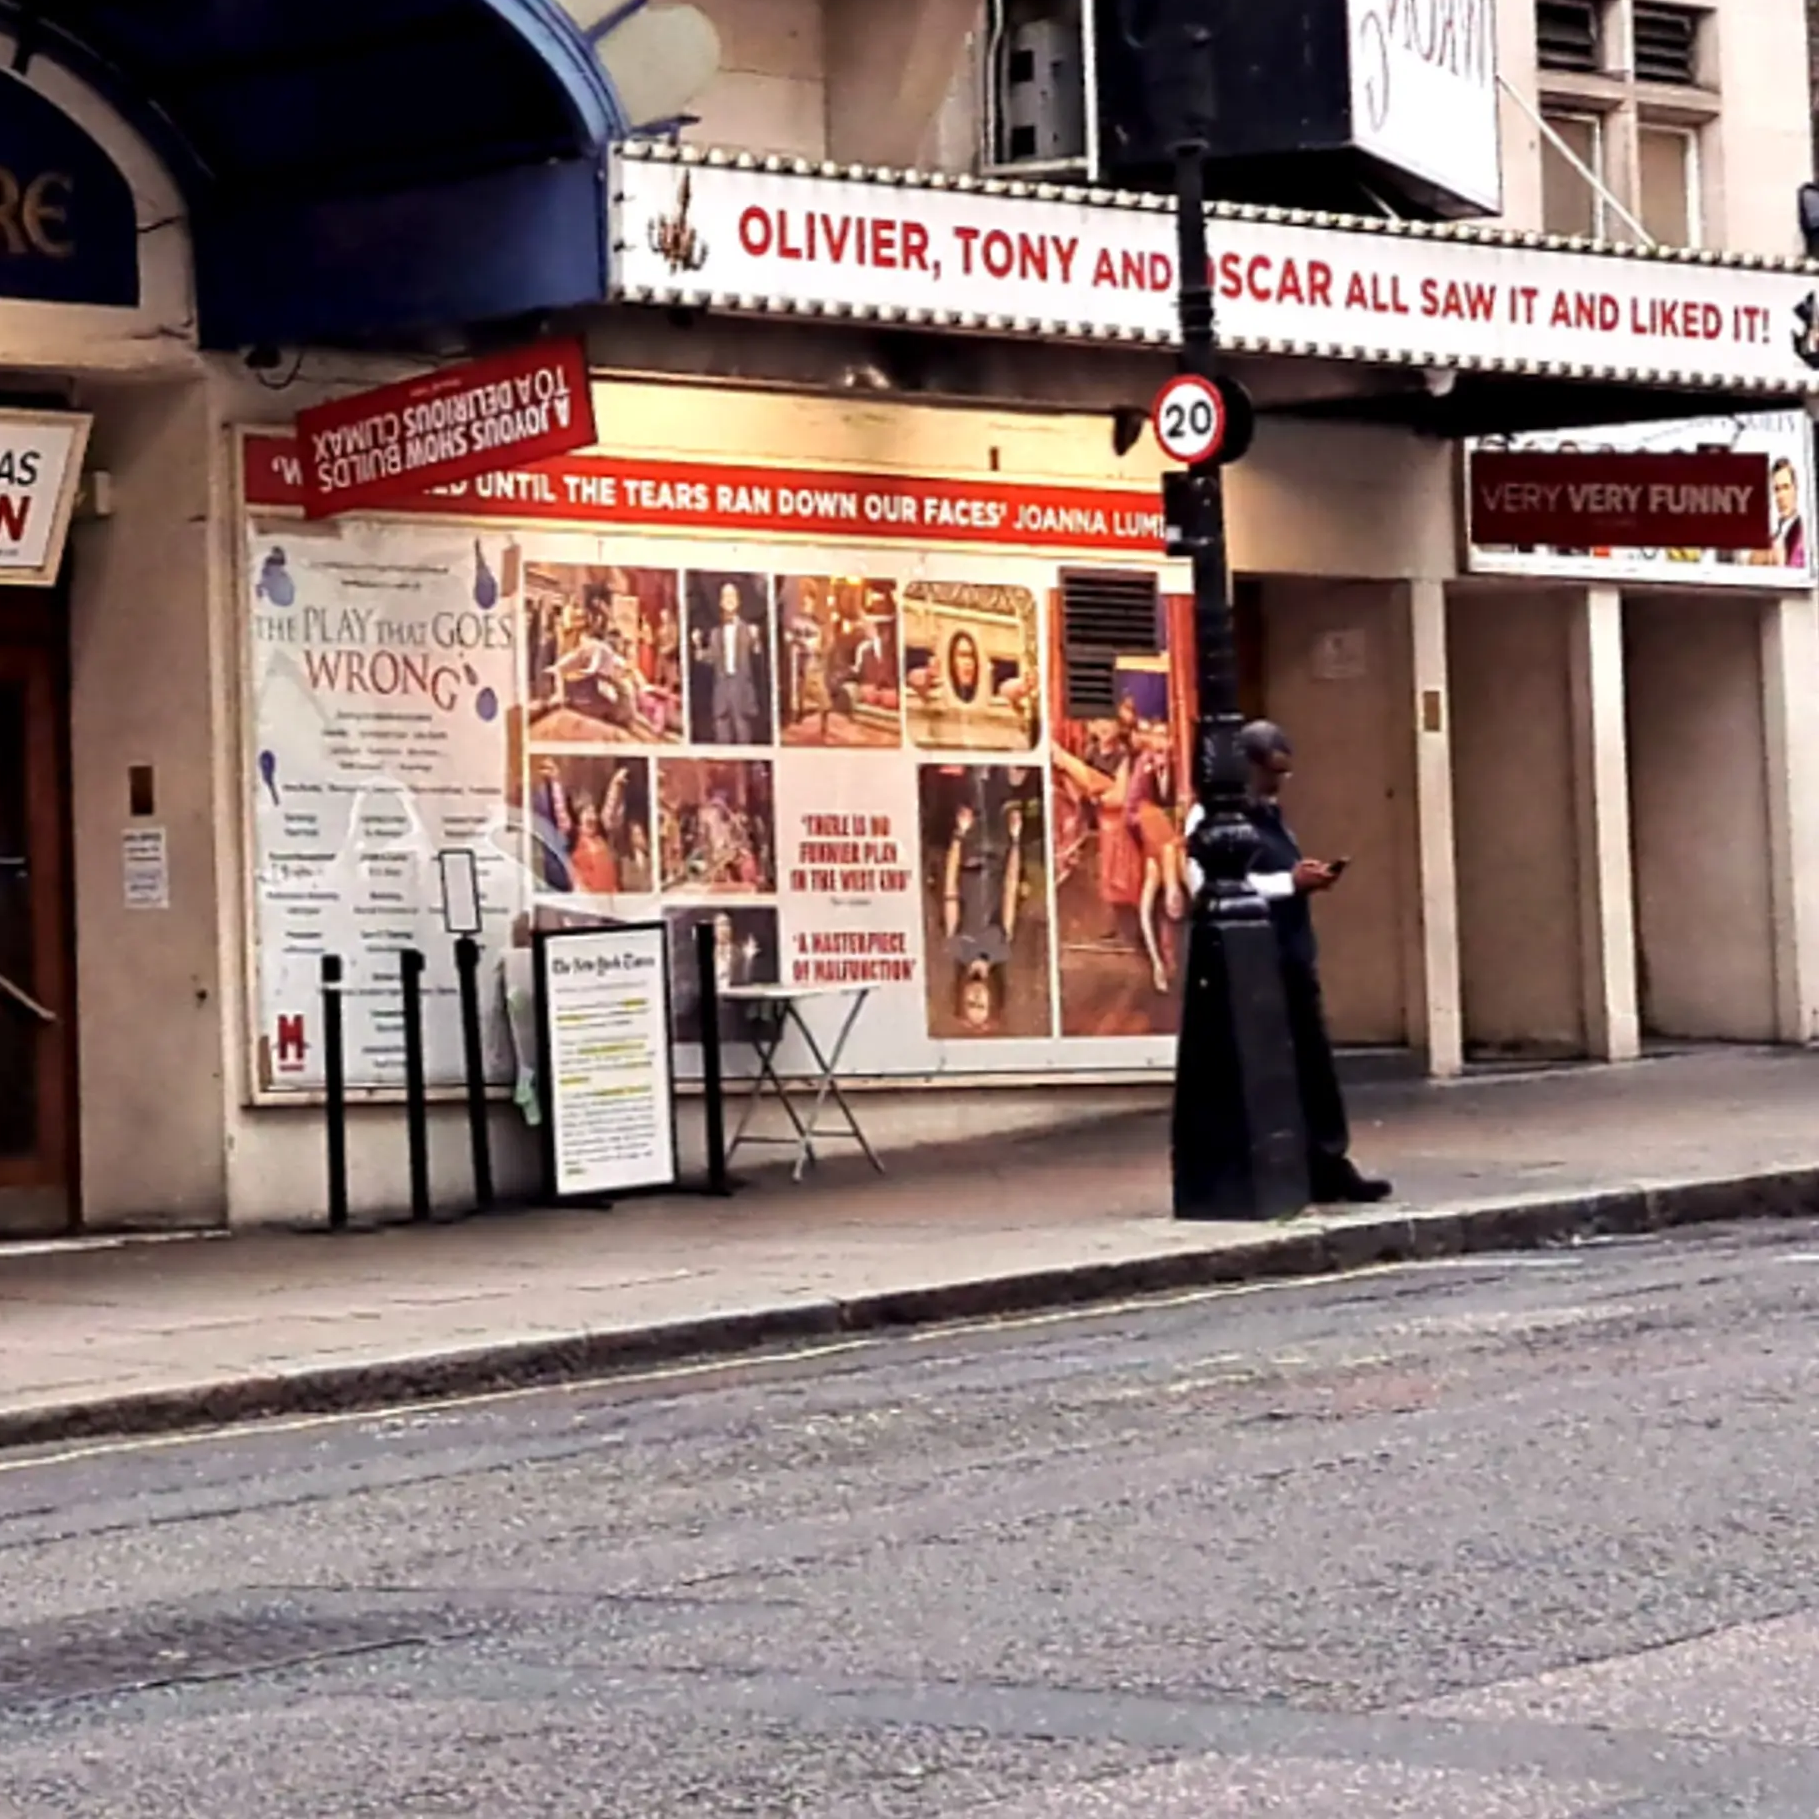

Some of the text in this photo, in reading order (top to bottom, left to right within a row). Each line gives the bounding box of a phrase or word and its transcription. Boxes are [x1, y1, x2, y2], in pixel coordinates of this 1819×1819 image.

[738, 203, 1771, 345] OLIVIER, TONY AND SCAR ALL SAW IT AND LIKED IT!
[535, 365, 570, 397] TO
[403, 381, 512, 433] DELIRIOUS
[471, 399, 549, 451] JOYOUS
[1163, 400, 1213, 439] 20
[312, 412, 400, 462] CLIMAX
[407, 427, 467, 469] SHOW
[318, 443, 401, 493] BUILDS
[476, 474, 556, 502] UNTIL
[563, 476, 617, 505] THE
[623, 478, 709, 512] TEARS
[716, 486, 771, 514] RAN
[777, 489, 857, 519] DOWN
[864, 495, 918, 523] OUR
[1012, 506, 1106, 534] JOANNA
[1480, 483, 1753, 514] VERY VERY FUNNY
[303, 606, 375, 643] PLAY
[432, 611, 513, 649] GOES
[303, 649, 461, 712] WRONG
